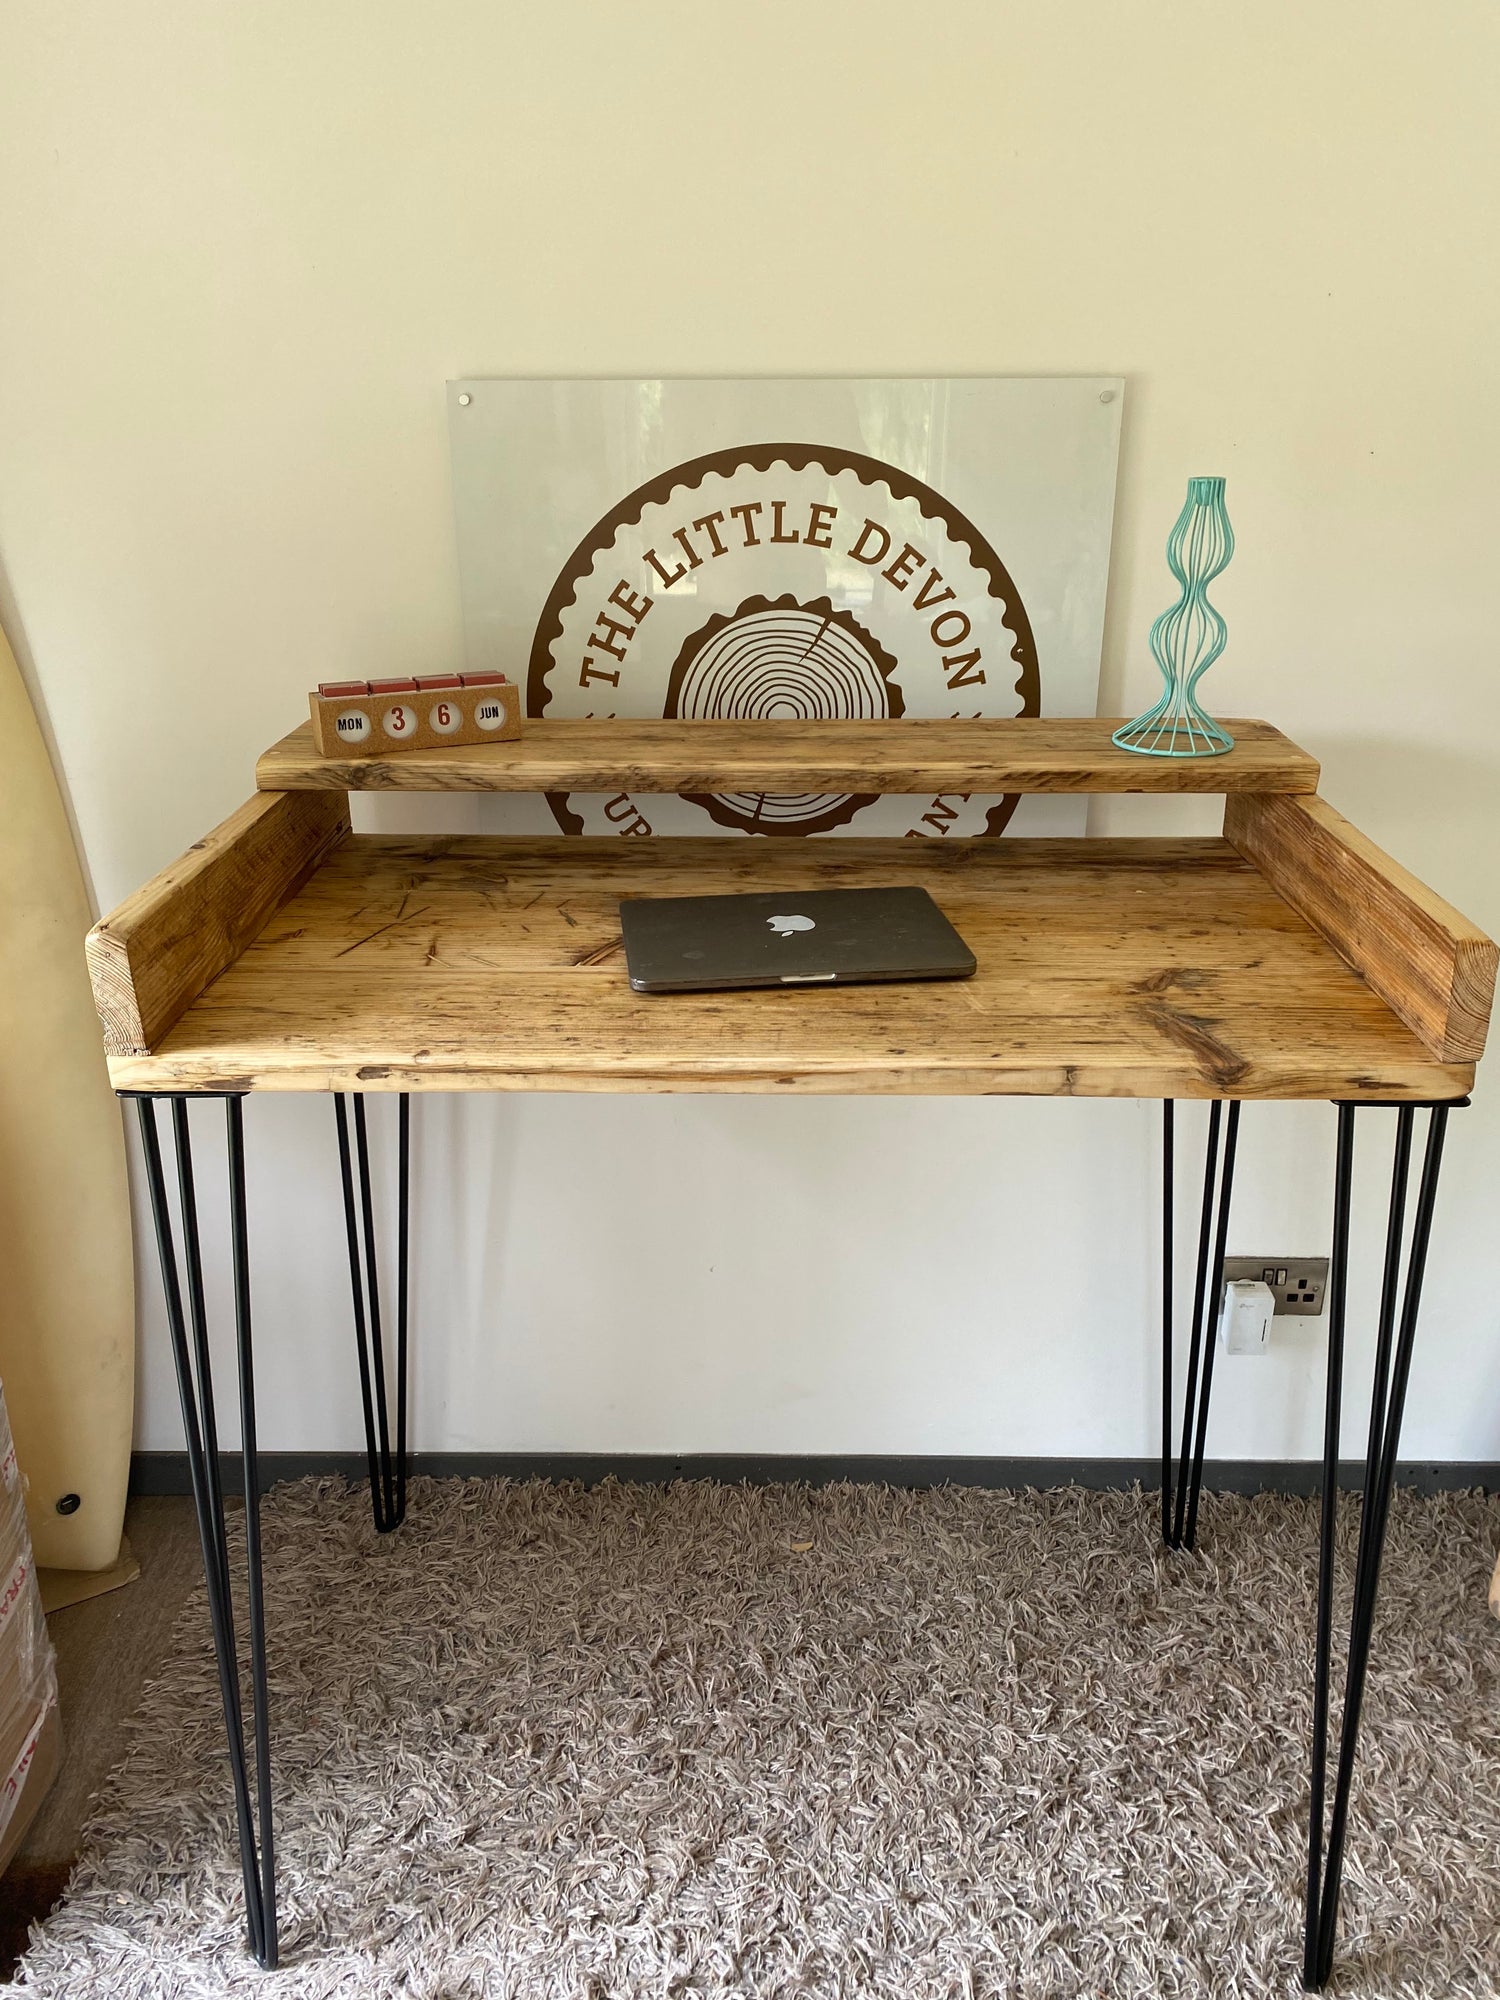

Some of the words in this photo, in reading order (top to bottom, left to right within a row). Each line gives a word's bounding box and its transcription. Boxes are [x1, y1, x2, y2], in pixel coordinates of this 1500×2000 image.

[579, 579, 654, 688] THE
[642, 501, 838, 590] LITTLE
[847, 518, 986, 690] DEVON
[337, 717, 363, 731] MON
[391, 707, 406, 731] 3
[437, 703, 451, 726] 6
[480, 705, 500, 721] JUN
